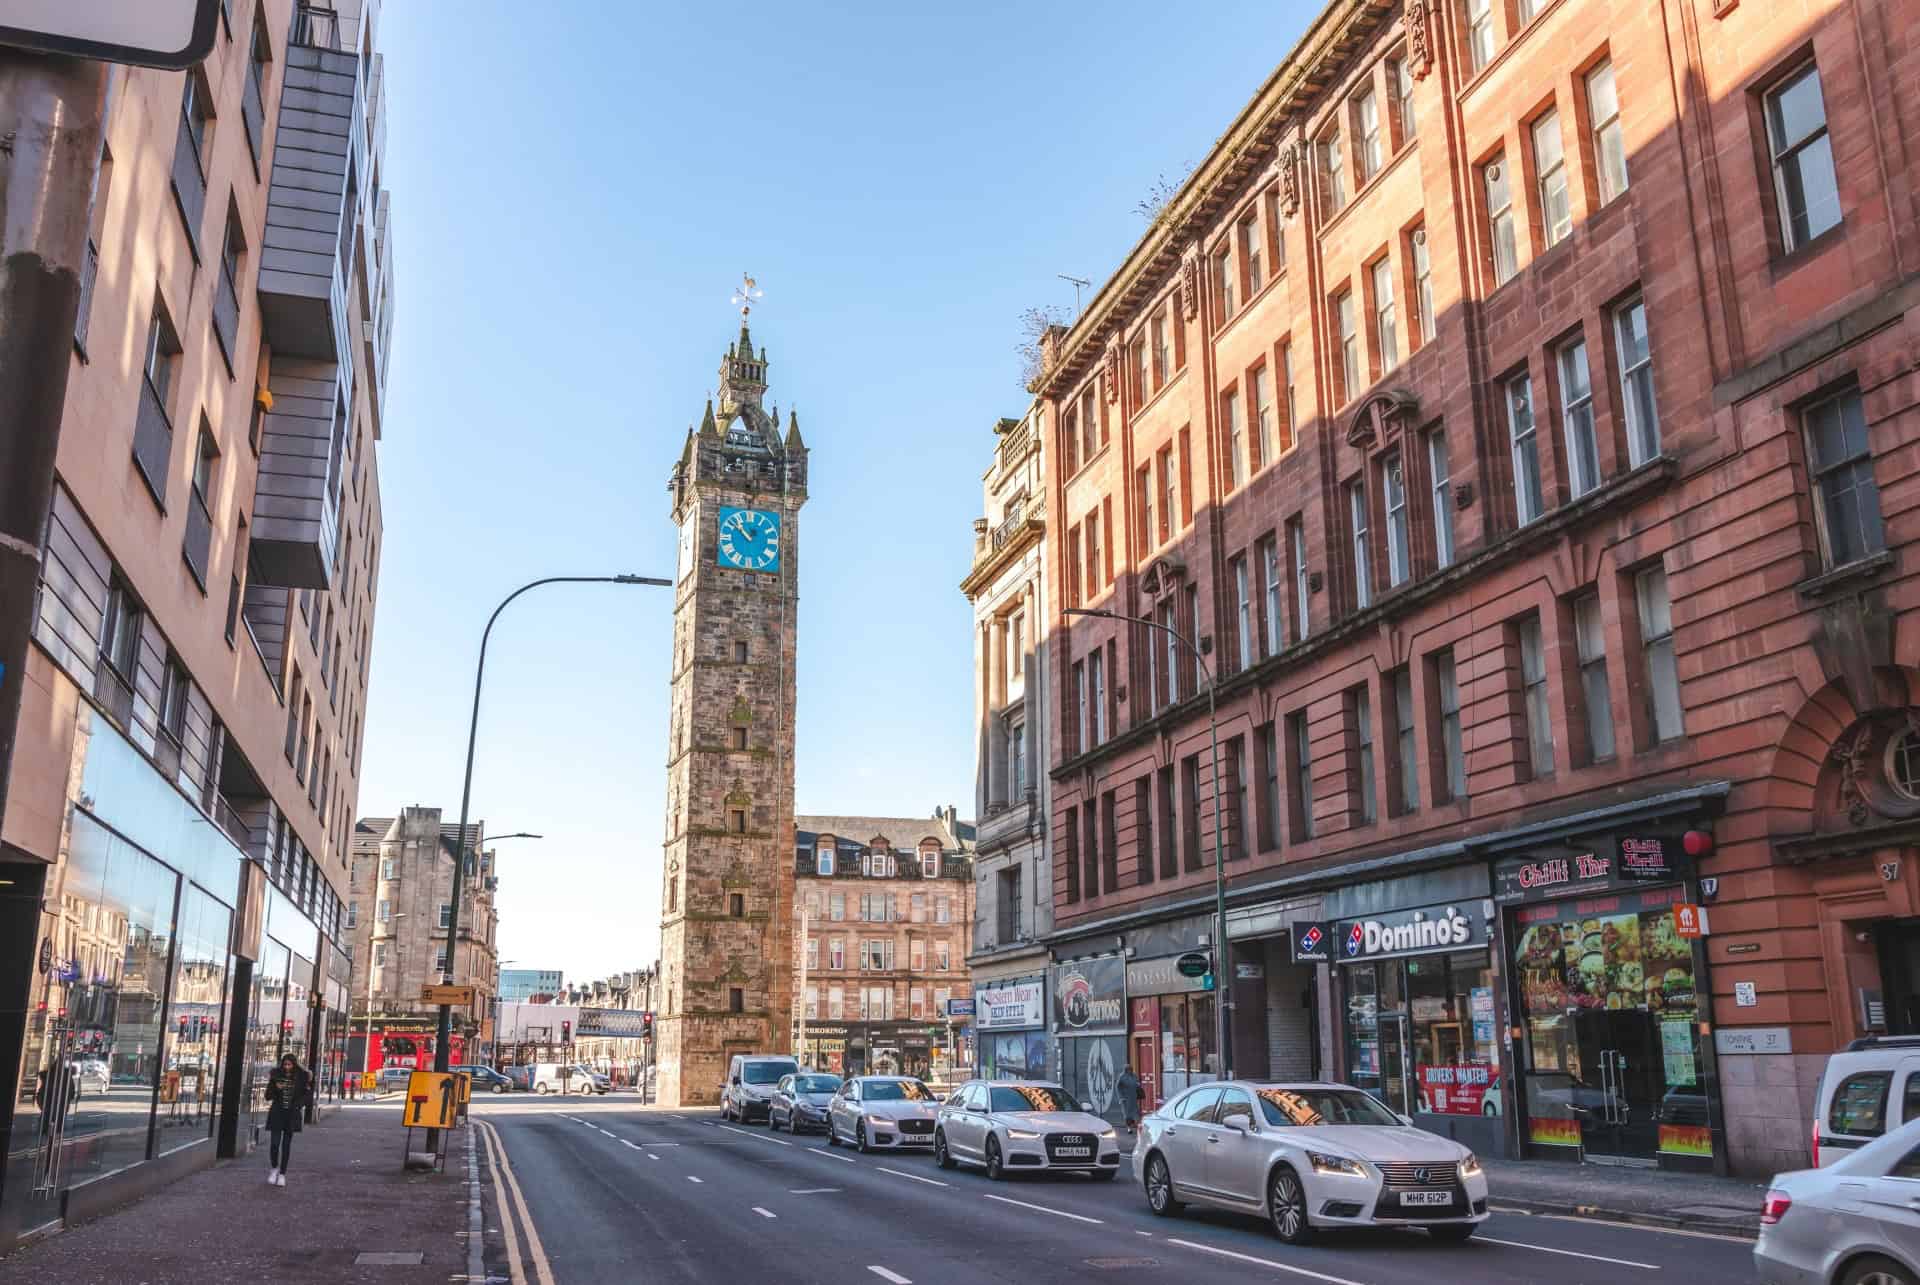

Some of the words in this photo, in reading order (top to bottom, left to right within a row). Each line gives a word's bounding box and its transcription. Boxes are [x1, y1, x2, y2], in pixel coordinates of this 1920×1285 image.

[1623, 838, 1662, 852] Chilli
[1624, 853, 1665, 867] Thrill
[1519, 859, 1569, 888] Chilli
[1880, 863, 1897, 880] 37
[1364, 905, 1470, 953] Domino's
[1298, 951, 1327, 960] Domino's
[1426, 1067, 1454, 1084] DRIVERS
[1456, 1067, 1489, 1085] WANTED!
[1406, 1192, 1425, 1203] MHR
